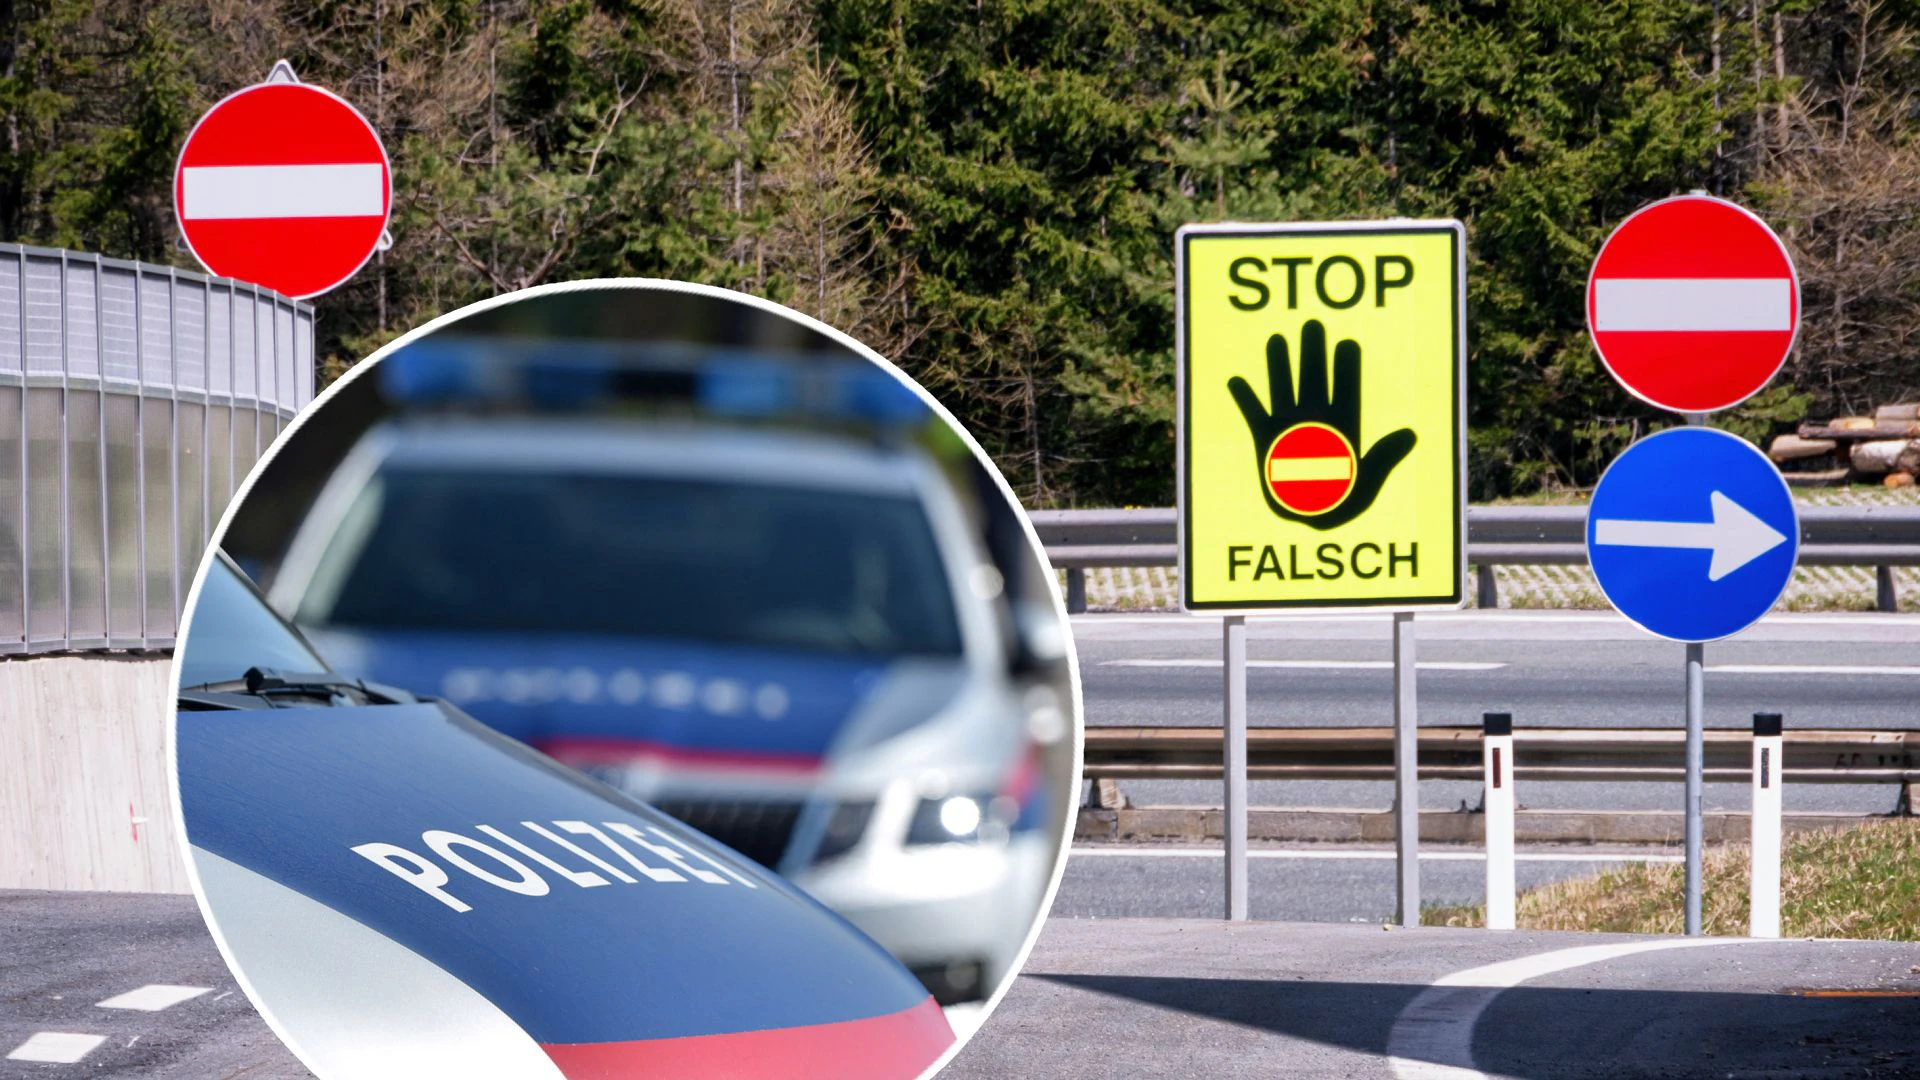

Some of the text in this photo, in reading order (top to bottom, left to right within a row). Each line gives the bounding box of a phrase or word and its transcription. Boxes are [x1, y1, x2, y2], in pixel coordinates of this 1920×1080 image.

[1228, 255, 1414, 311] STOP
[1228, 542, 1418, 581] FALSCH
[350, 820, 757, 913] POLIZEI
